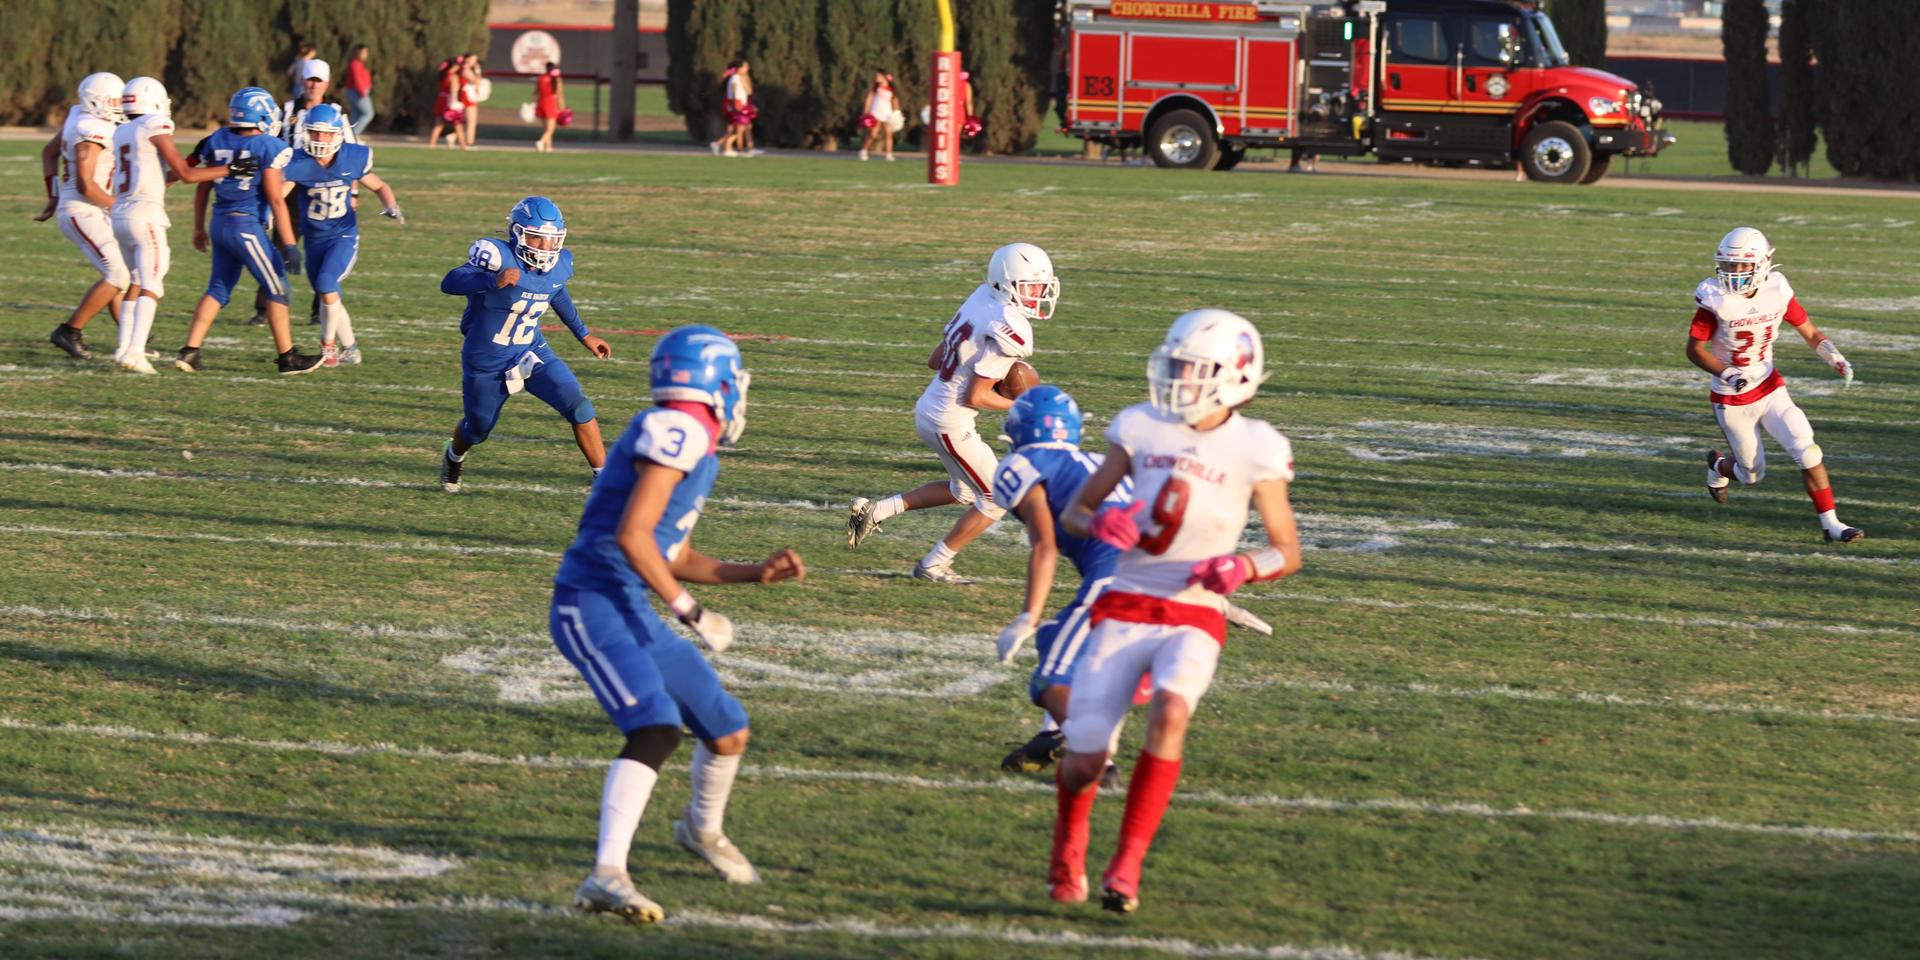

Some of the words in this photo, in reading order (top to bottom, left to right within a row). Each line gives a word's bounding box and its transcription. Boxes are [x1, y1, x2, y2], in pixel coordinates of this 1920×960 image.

[1111, 2, 1211, 19] CHOWCHILLA
[1218, 6, 1257, 20] FIRE
[1083, 76, 1114, 96] E3
[935, 56, 952, 180] REDSKINS
[307, 186, 351, 220] 88
[492, 300, 549, 346] 18
[1731, 326, 1773, 367] 21
[661, 427, 686, 458] 3
[995, 466, 1022, 503] 10
[1137, 476, 1190, 556] 9
